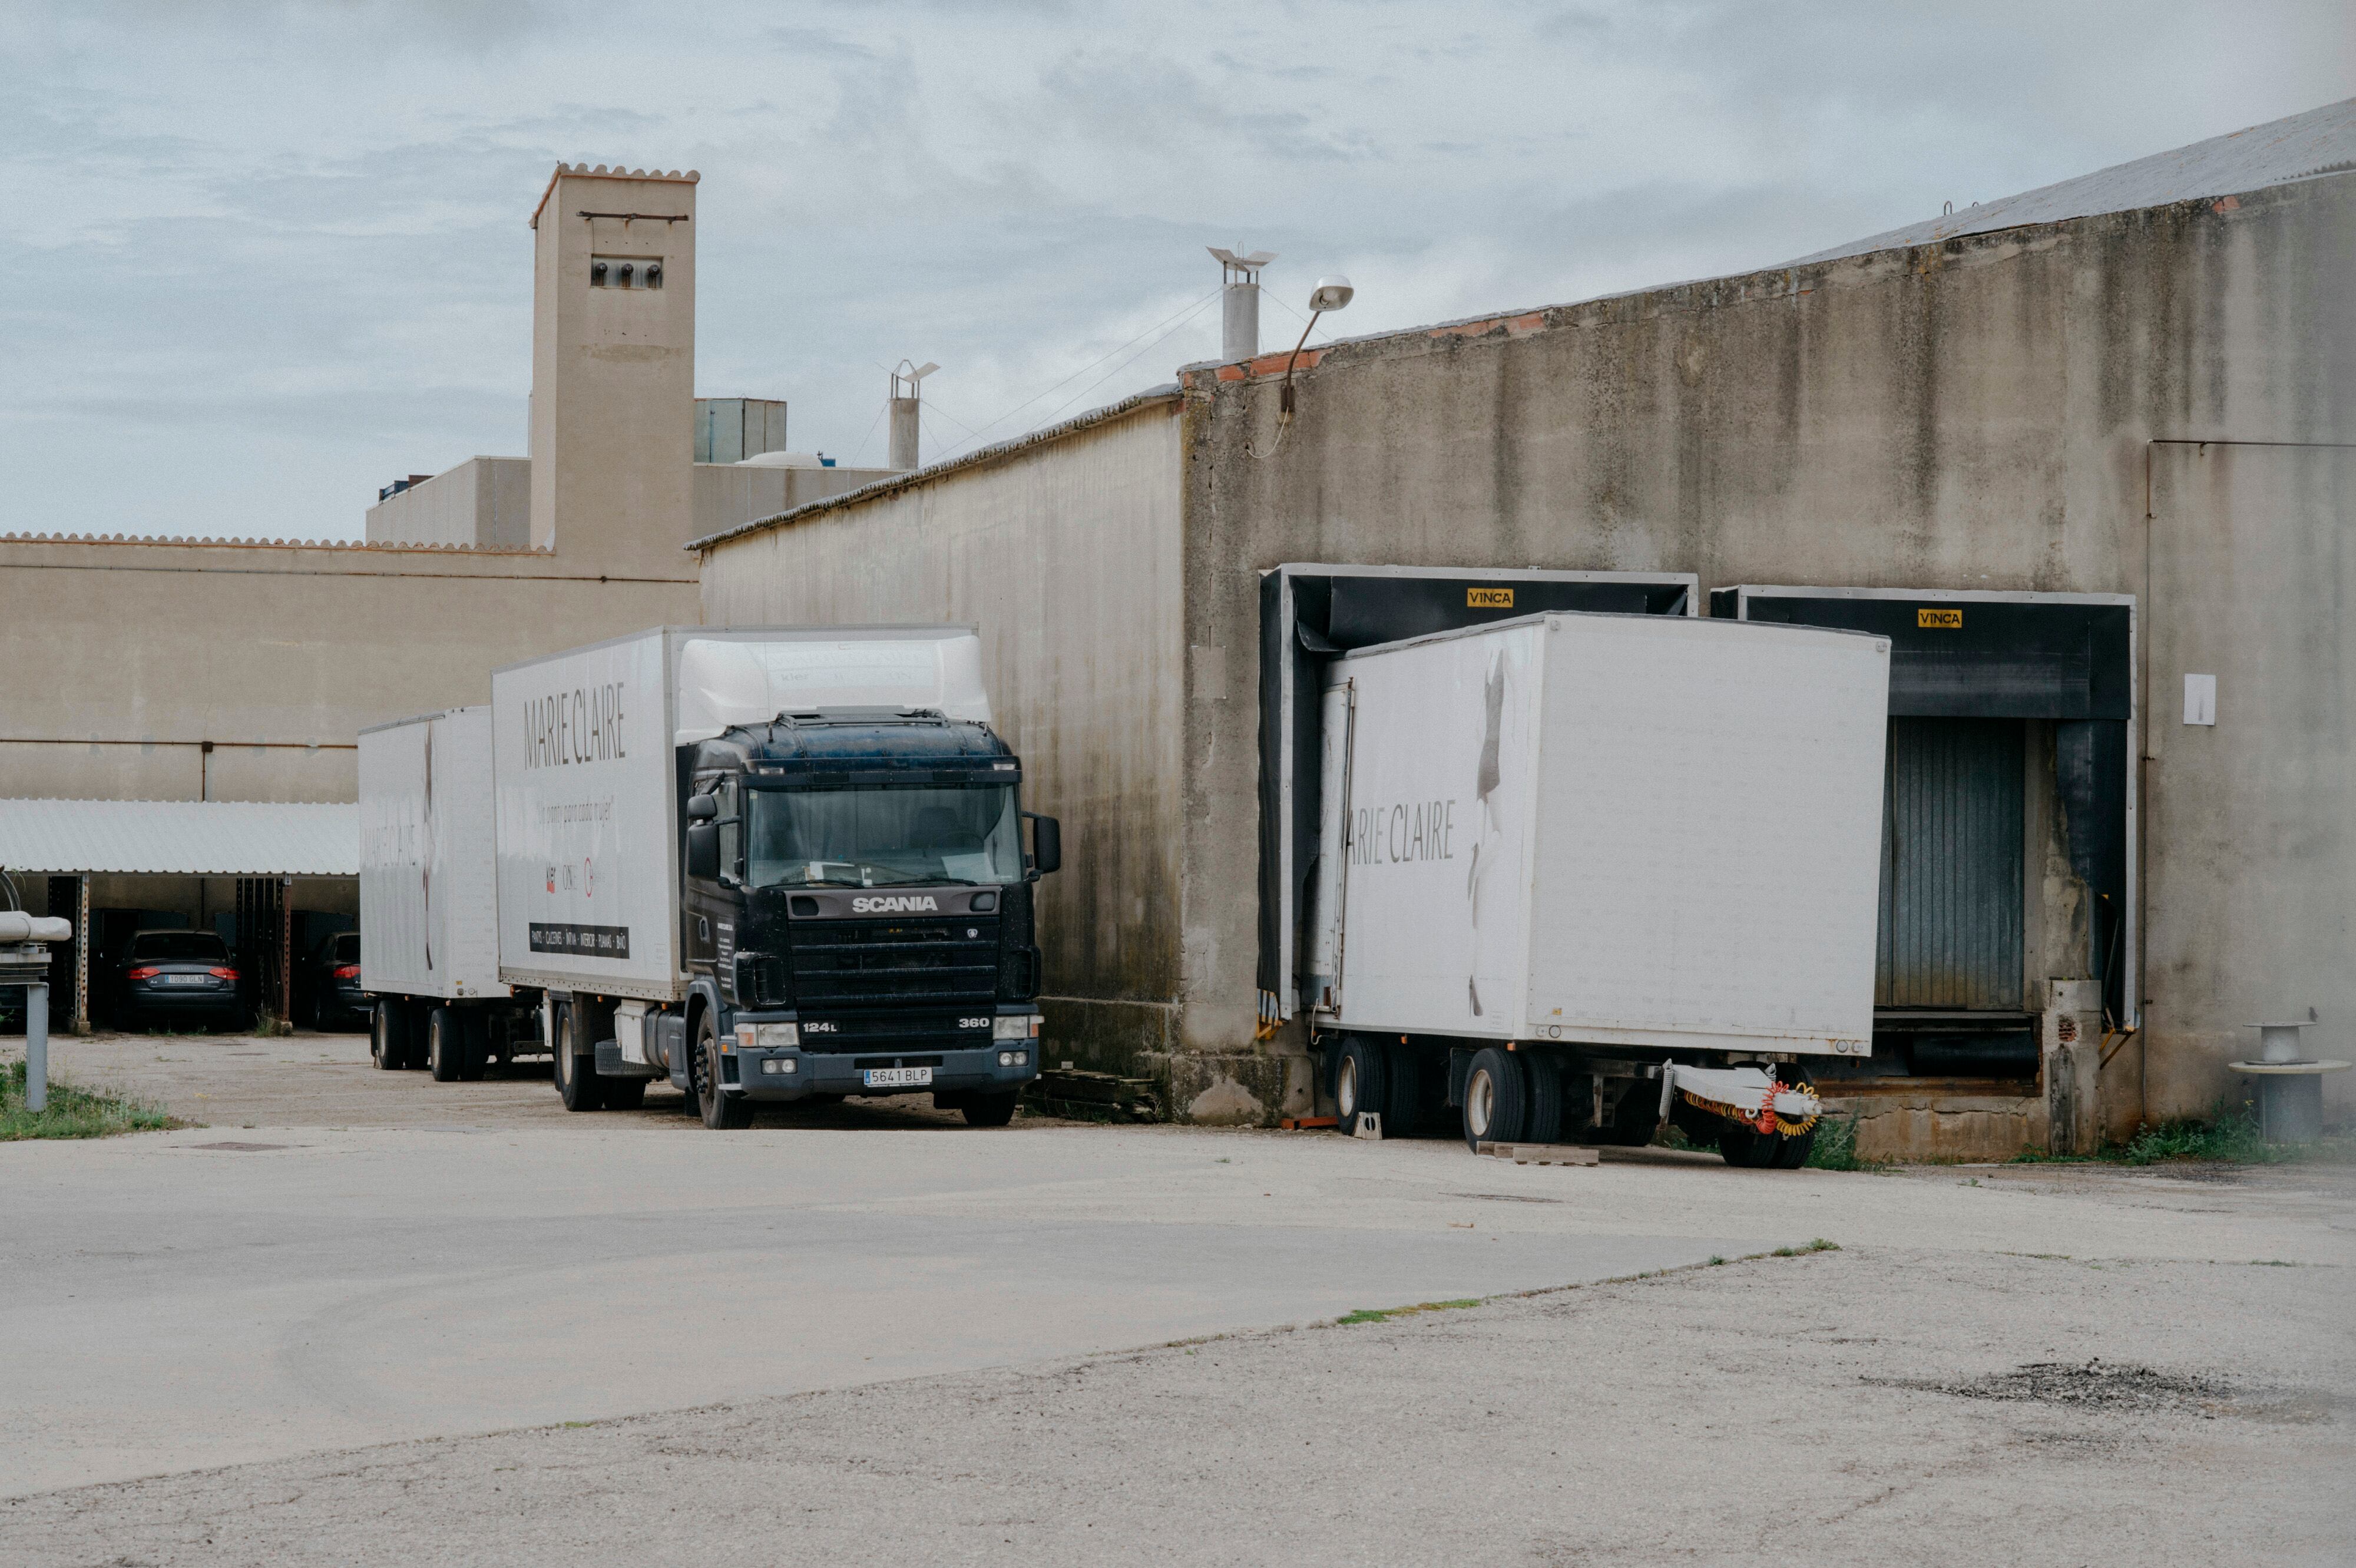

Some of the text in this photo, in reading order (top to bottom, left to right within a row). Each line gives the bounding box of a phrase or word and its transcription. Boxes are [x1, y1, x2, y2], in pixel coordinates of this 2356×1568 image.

[1470, 593, 1511, 603] VINCA
[1920, 613, 1960, 624] VINCA
[525, 682, 626, 770] MARIE CLAIRE
[1346, 799, 1455, 865] ARIE CLAIRE
[852, 896, 938, 913] SCANIA
[959, 1018, 990, 1028] 360
[872, 1070, 927, 1081] 5641 BLP
